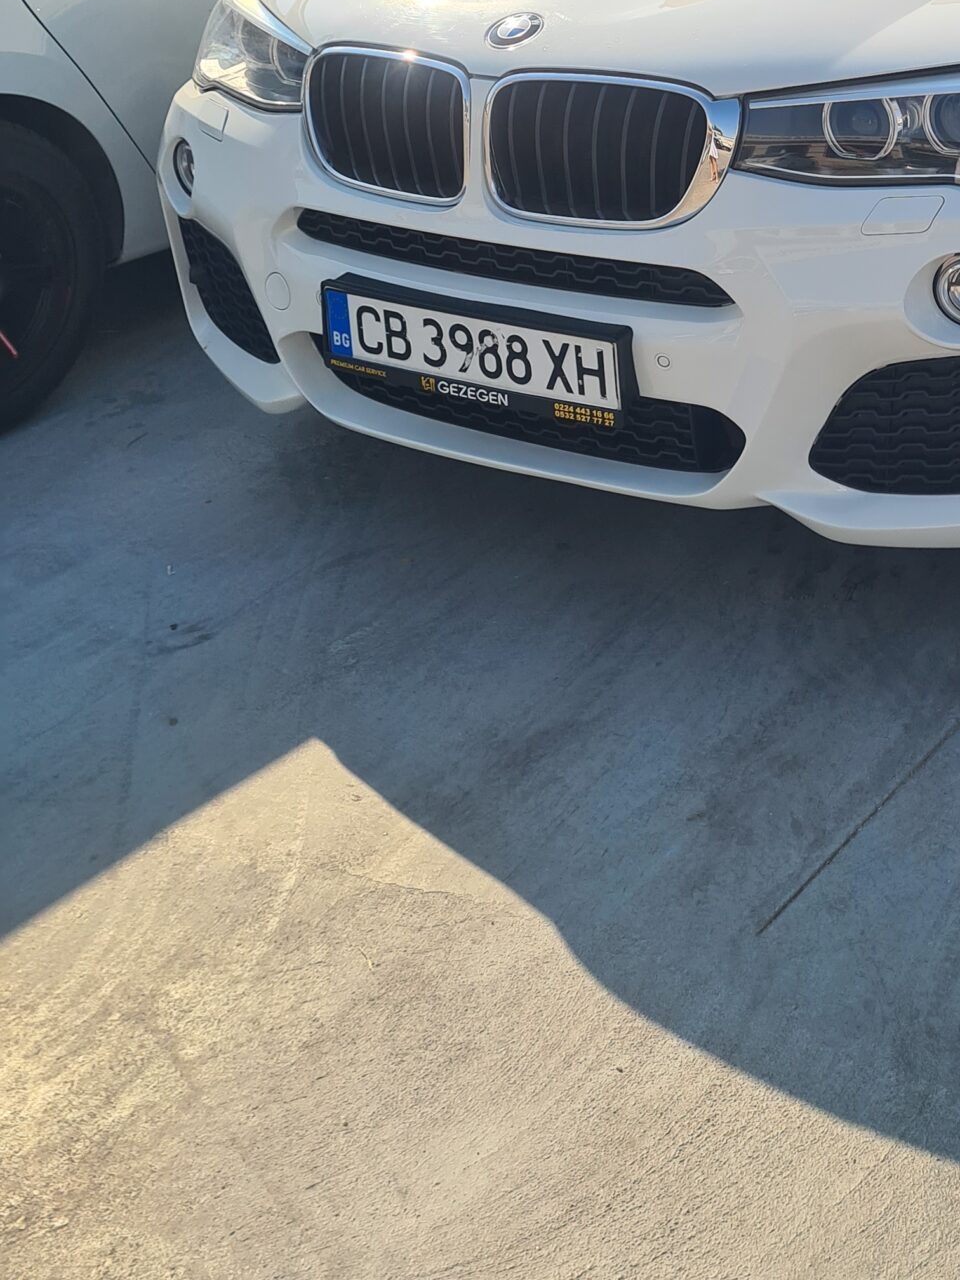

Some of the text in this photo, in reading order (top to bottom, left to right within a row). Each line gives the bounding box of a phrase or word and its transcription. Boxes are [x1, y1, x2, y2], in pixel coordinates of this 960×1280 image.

[332, 330, 351, 348] BG
[356, 305, 608, 400] CB 3988 XH
[437, 380, 509, 407] GEZEGEN
[554, 402, 575, 413] 0224
